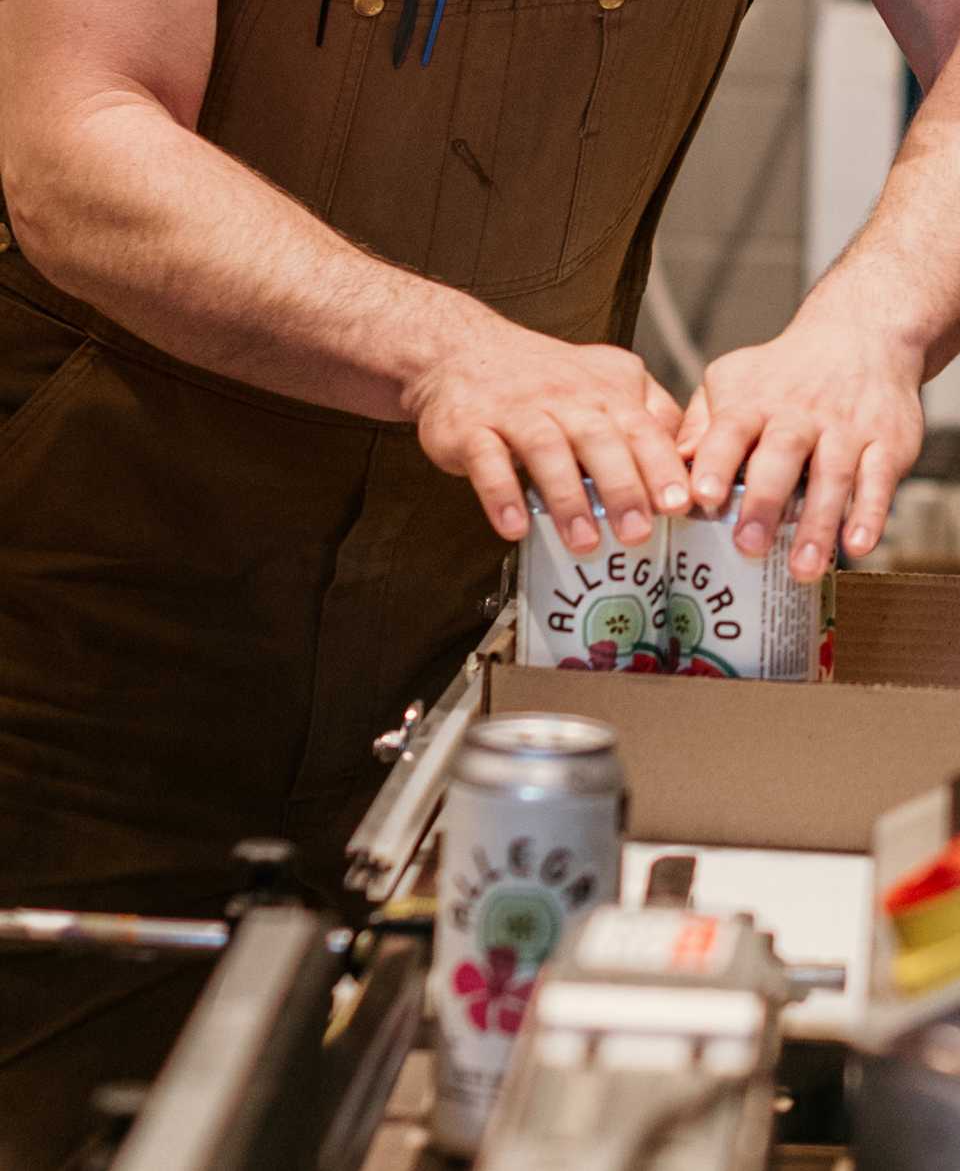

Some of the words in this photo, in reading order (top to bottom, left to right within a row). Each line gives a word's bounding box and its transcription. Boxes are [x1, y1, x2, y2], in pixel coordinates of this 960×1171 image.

[547, 551, 668, 633] ALLEGRO
[670, 551, 742, 640] EGRO
[452, 836, 597, 931] ALLEGR
